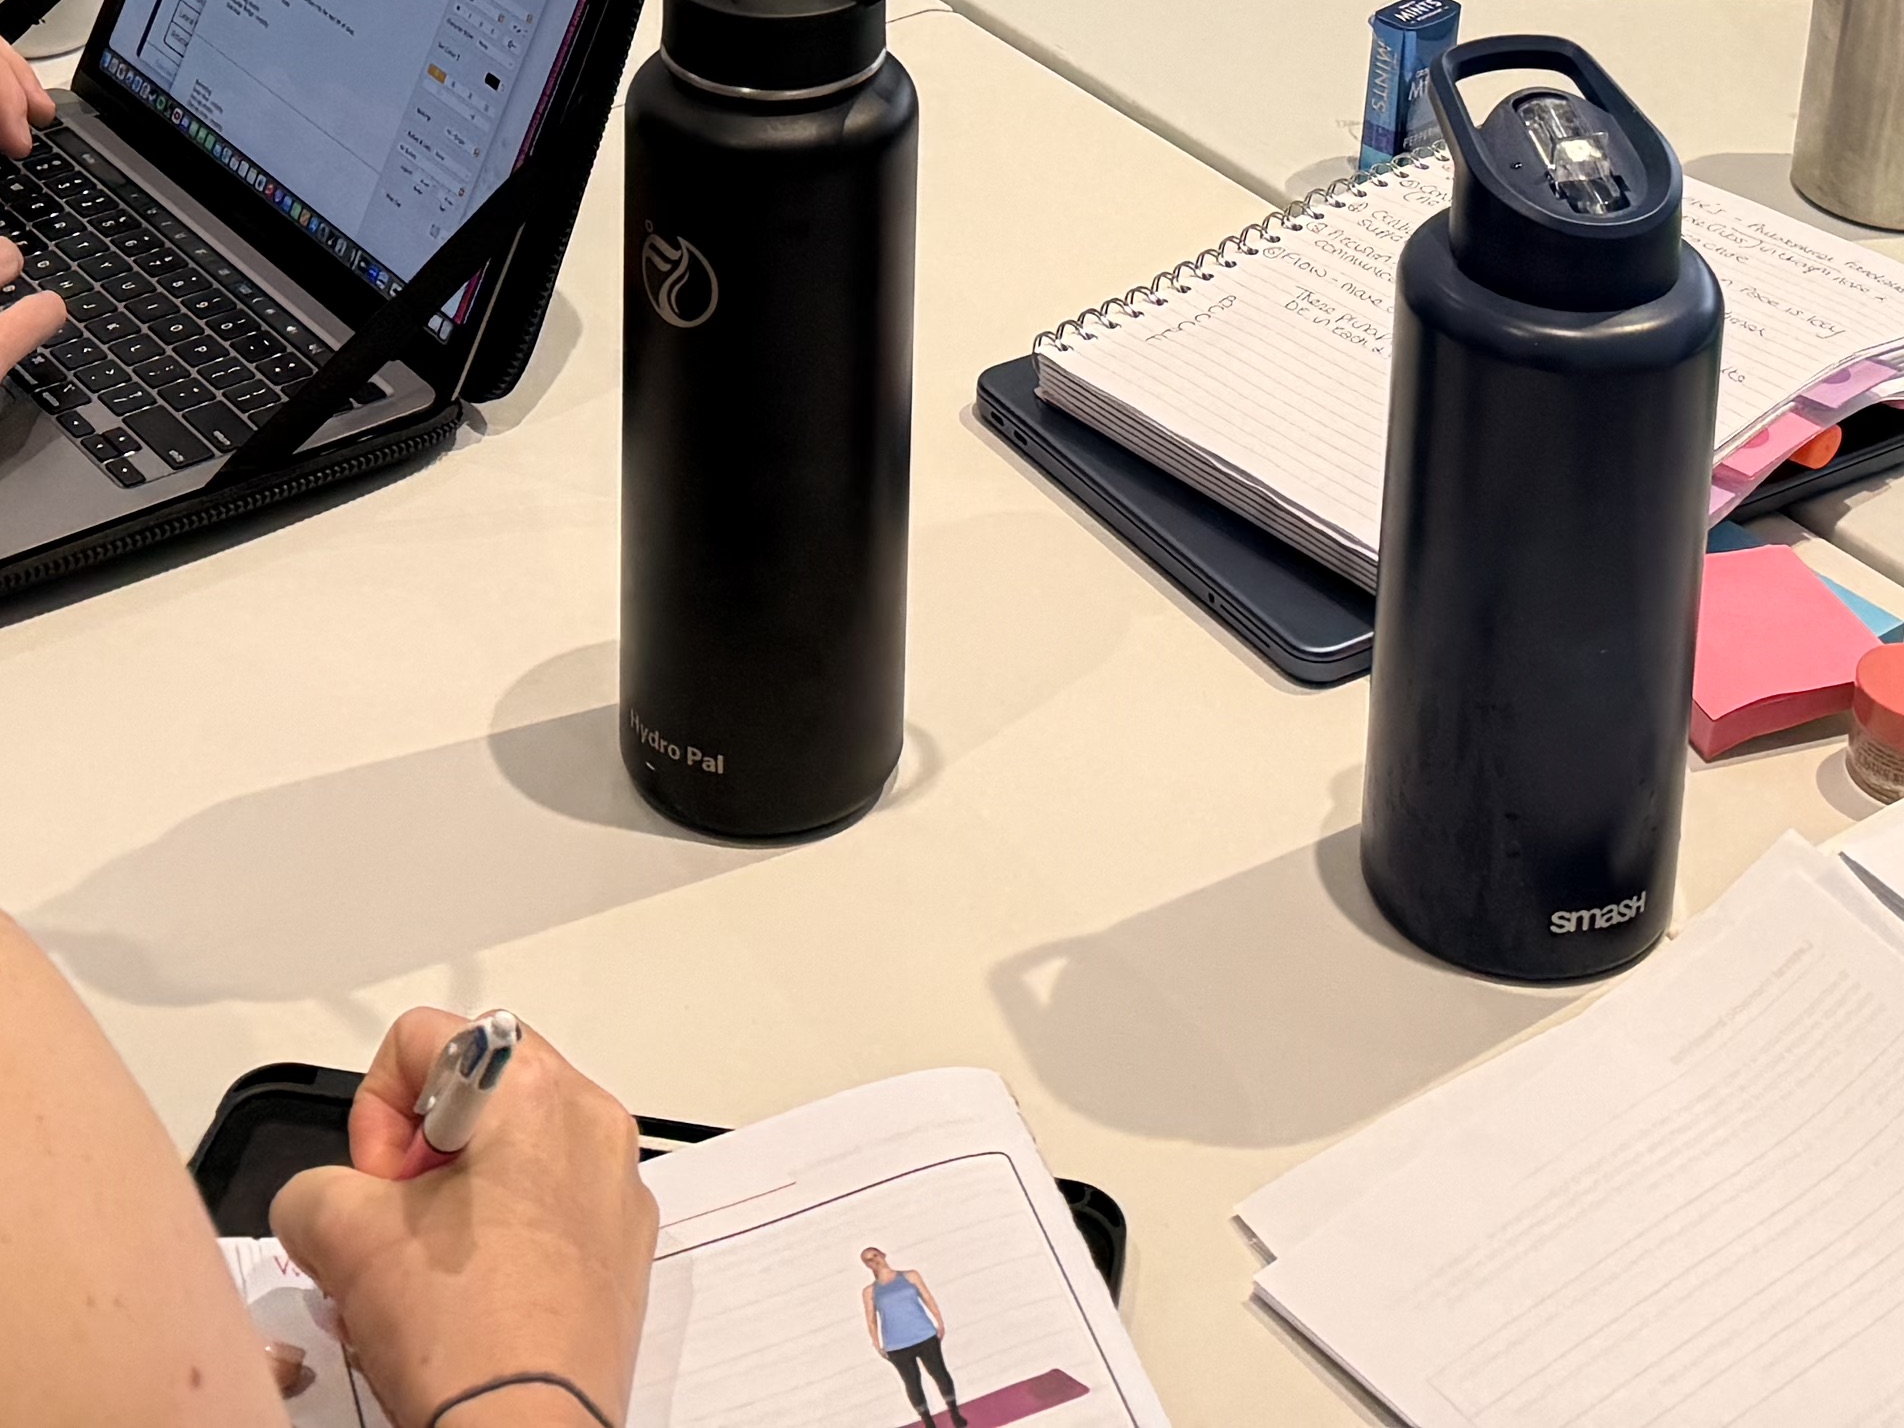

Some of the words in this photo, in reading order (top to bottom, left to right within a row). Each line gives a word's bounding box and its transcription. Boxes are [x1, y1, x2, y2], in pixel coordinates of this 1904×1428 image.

[1394, 0, 1443, 23] MINTS
[1372, 38, 1393, 115] MINTS
[629, 704, 682, 763] Hydro
[686, 745, 724, 775] Pal
